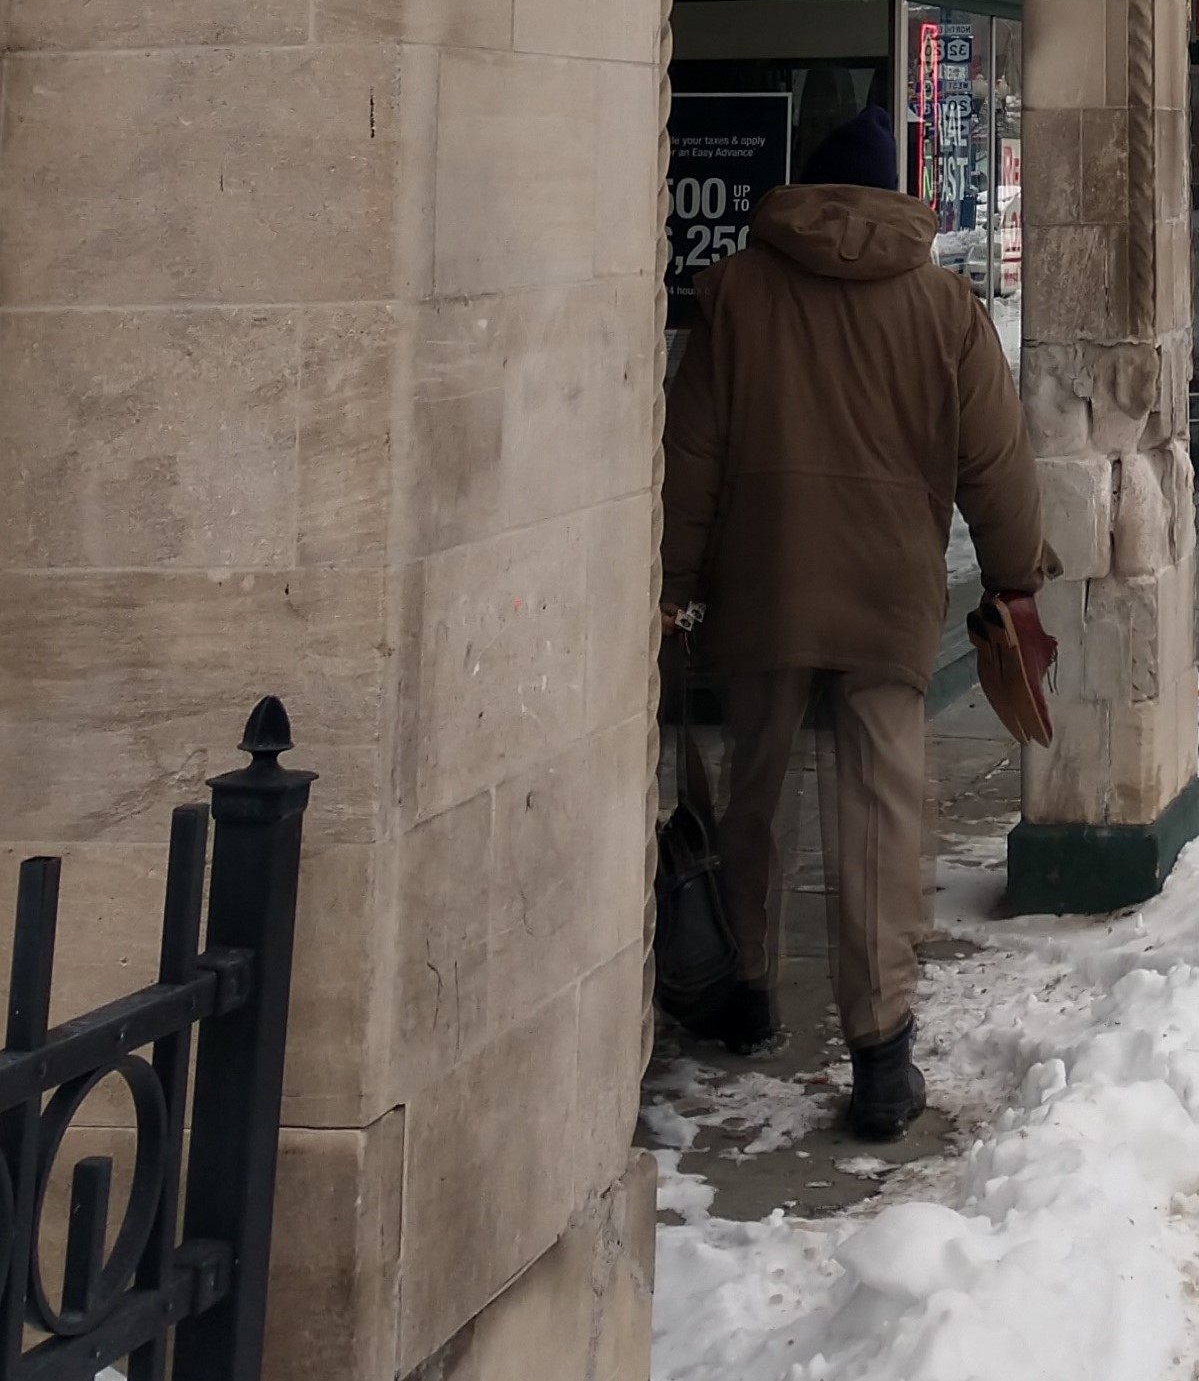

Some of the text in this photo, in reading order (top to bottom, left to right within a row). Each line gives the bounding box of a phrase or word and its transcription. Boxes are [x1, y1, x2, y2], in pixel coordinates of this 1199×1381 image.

[705, 136, 730, 145] taxes
[731, 136, 738, 144] &
[740, 136, 766, 147] apply
[692, 148, 713, 158] Easy
[733, 184, 751, 197] UP
[733, 198, 750, 212] TO
